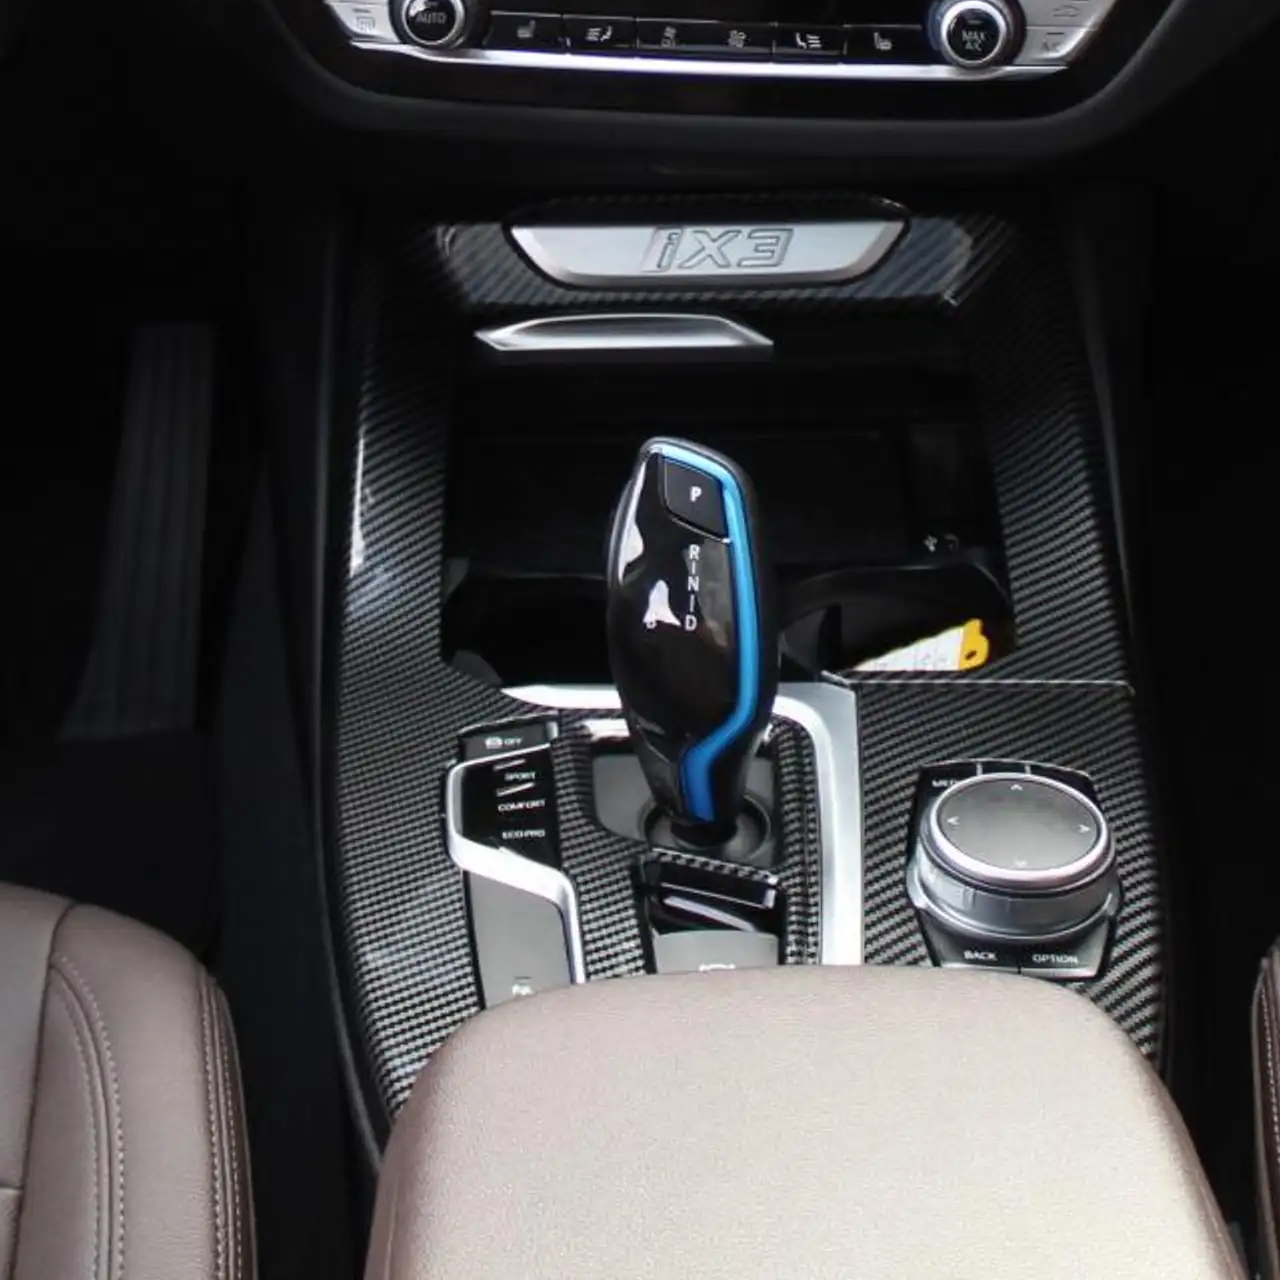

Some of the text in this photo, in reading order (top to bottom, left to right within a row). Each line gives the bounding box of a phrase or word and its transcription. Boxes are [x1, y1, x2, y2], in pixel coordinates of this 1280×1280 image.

[416, 12, 448, 24] AUTO
[961, 29, 987, 41] MAX
[690, 486, 703, 502] P
[684, 544, 701, 631] R N D
[504, 771, 536, 781] SPORT
[497, 800, 546, 812] COMFORT
[963, 950, 998, 961] BACK
[1032, 953, 1080, 965] OPTION
